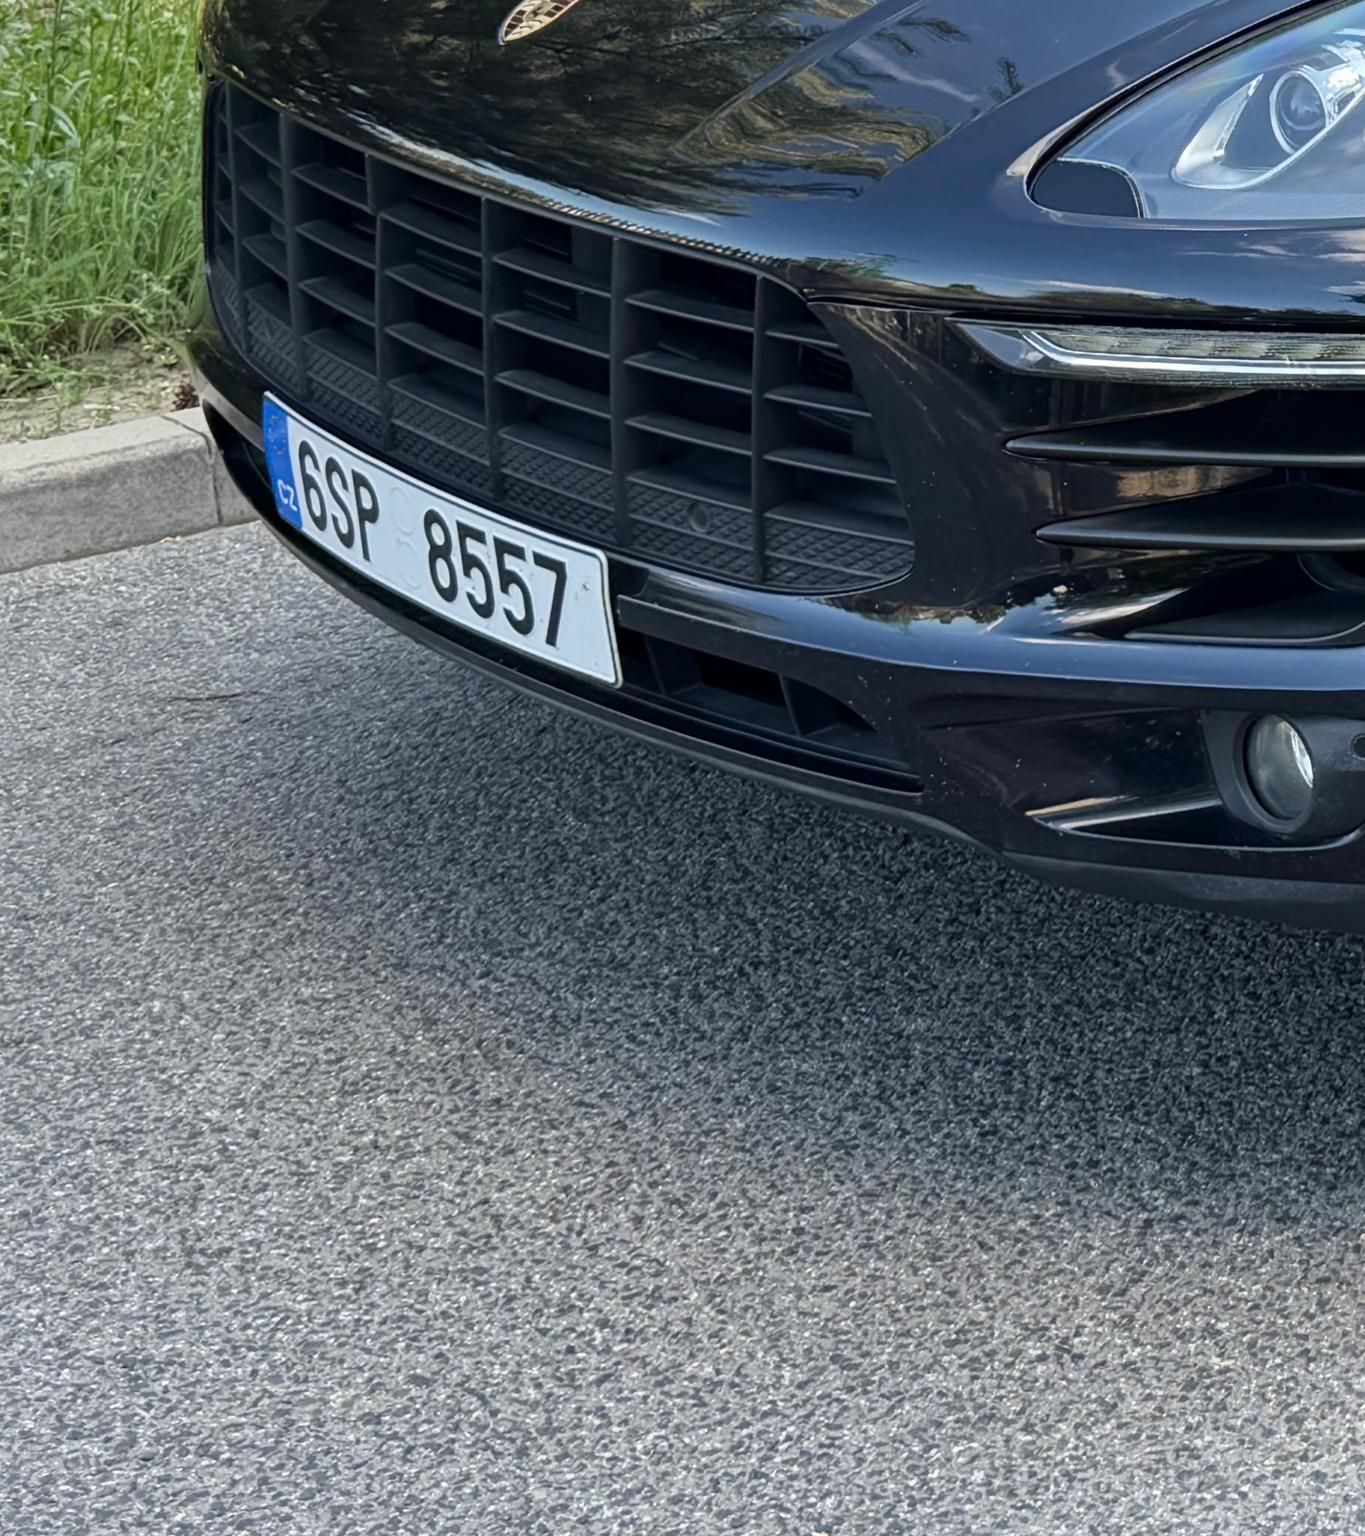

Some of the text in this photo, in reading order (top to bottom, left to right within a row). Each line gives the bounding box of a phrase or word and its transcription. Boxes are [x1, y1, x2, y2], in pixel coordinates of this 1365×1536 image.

[277, 479, 298, 511] CZ
[298, 440, 567, 648] 6SP 8557
